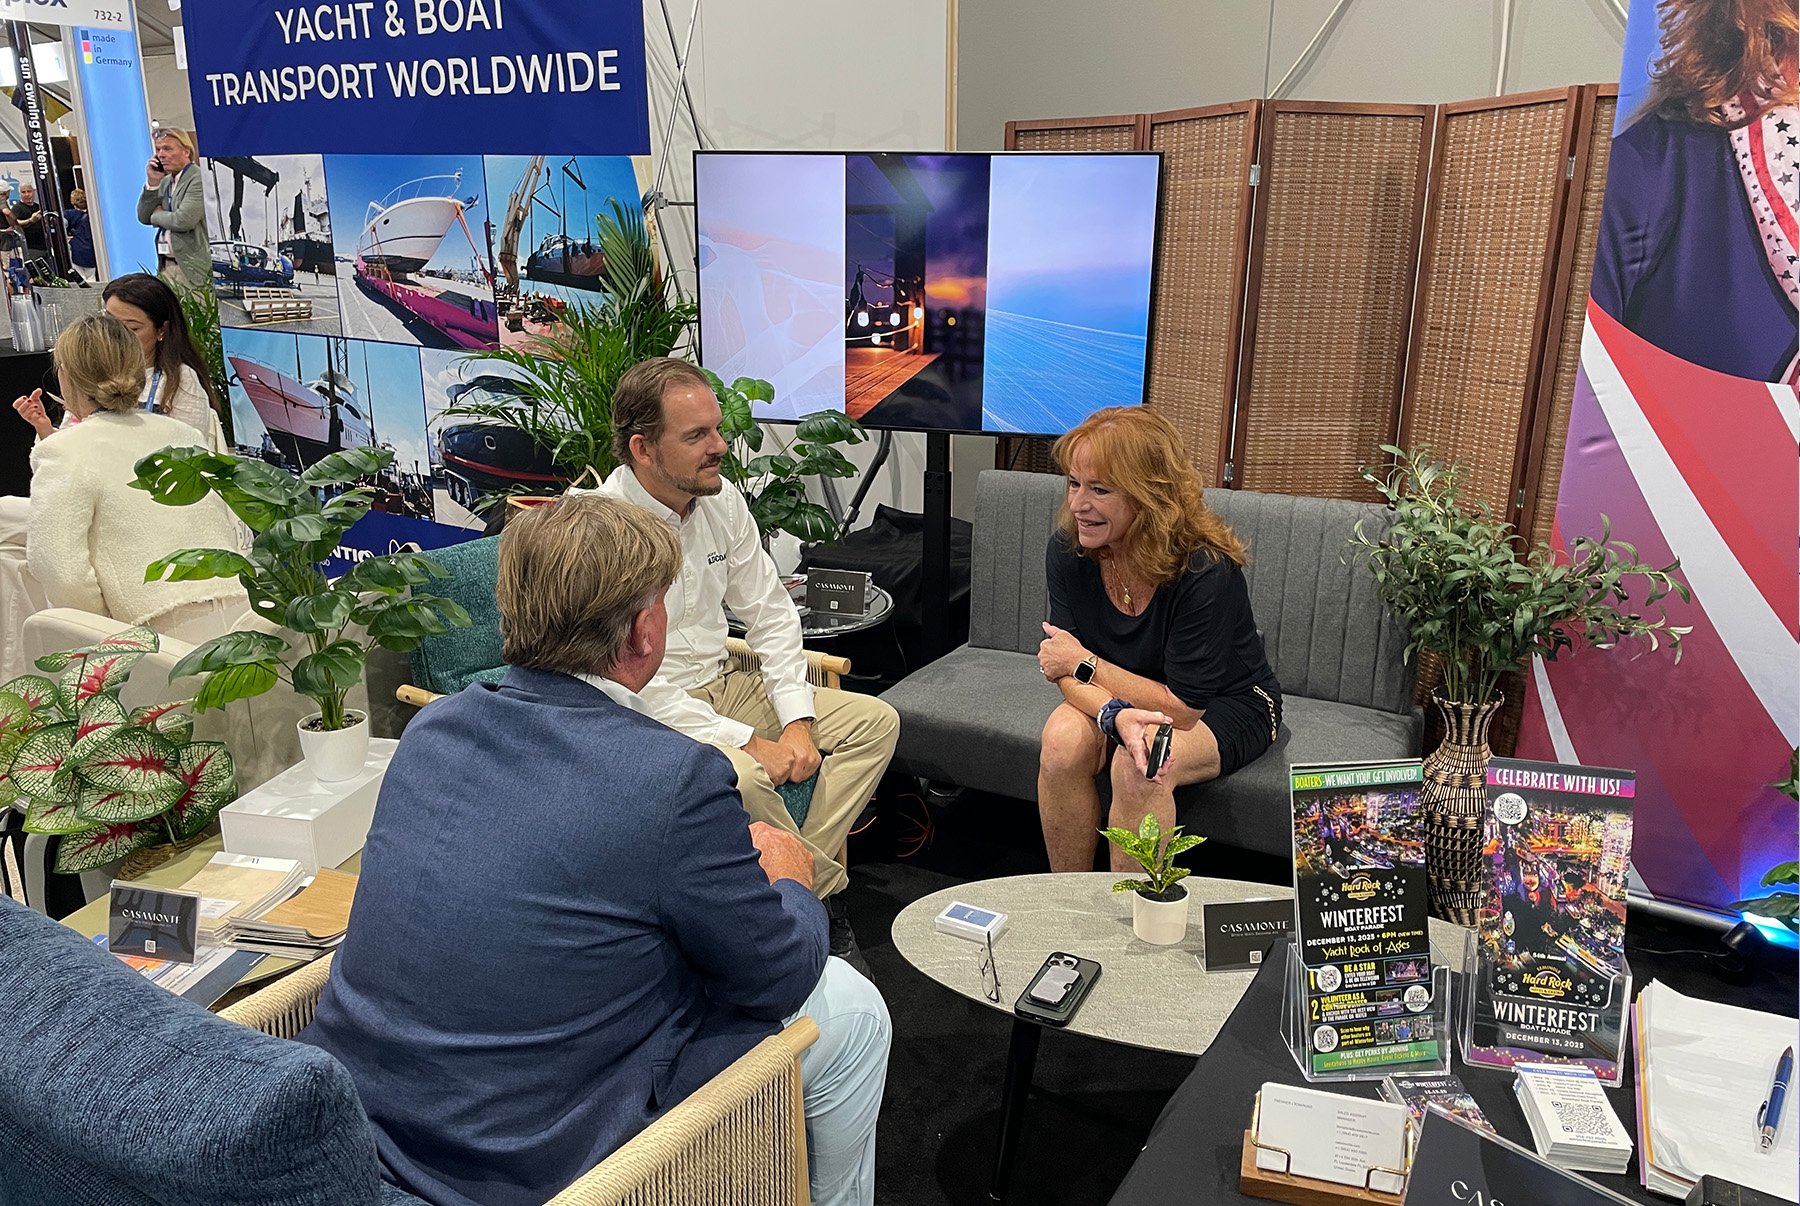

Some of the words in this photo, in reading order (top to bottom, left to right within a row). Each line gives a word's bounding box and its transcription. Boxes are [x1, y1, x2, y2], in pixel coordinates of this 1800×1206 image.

[94, 9, 122, 22] 732-2
[275, 3, 373, 44] YACHT
[384, 2, 406, 38] &
[92, 34, 116, 43] made
[94, 44, 102, 53] in
[19, 56, 31, 80] sun
[95, 56, 133, 68] Germany
[206, 62, 378, 107] TRANSPORT
[386, 49, 621, 99] WORLDWIDE
[24, 82, 41, 129] awning
[1336, 773, 1355, 786] WANT
[1355, 772, 1371, 784] YOU!
[1372, 771, 1384, 783] GET
[1385, 768, 1418, 781] INVOLVED!
[1496, 768, 1560, 790] CELEBRATE
[1563, 774, 1596, 793] WITH
[1600, 778, 1620, 796] US!
[1341, 881, 1361, 892] Hard
[1361, 879, 1381, 892] Rock
[122, 909, 181, 924] CASAMONTE
[1320, 904, 1405, 929] WINTERFEST
[1220, 920, 1289, 933] CASAMONTE
[1360, 923, 1385, 931] PARADE
[1306, 936, 1346, 946] DECEMBER
[1346, 935, 1357, 943] 13,
[1357, 933, 1375, 942] 2025
[1321, 944, 1347, 960] Yacht
[1349, 943, 1371, 957] Rock
[1372, 941, 1382, 955] of
[1384, 940, 1410, 954] Ages
[1546, 954, 1567, 962] Annual
[1343, 963, 1353, 973] BE
[1353, 962, 1359, 972] A
[1359, 962, 1376, 971] STAR
[1522, 973, 1548, 986] Hard
[1548, 976, 1573, 991] Rock
[1311, 999, 1320, 1020] 2
[1352, 992, 1360, 1000] AS
[1360, 991, 1365, 1000] A
[1492, 1000, 1600, 1032] WINTERFEST
[1520, 1023, 1540, 1032] BOAT
[1540, 1025, 1571, 1036] PARADE
[1505, 1032, 1550, 1044] DECEMBER
[1551, 1038, 1562, 1047] 13,
[1564, 1040, 1584, 1049] 2025
[1355, 1050, 1364, 1058] GET
[1364, 1048, 1381, 1057] PERKS
[1388, 1045, 1409, 1054] JOINING
